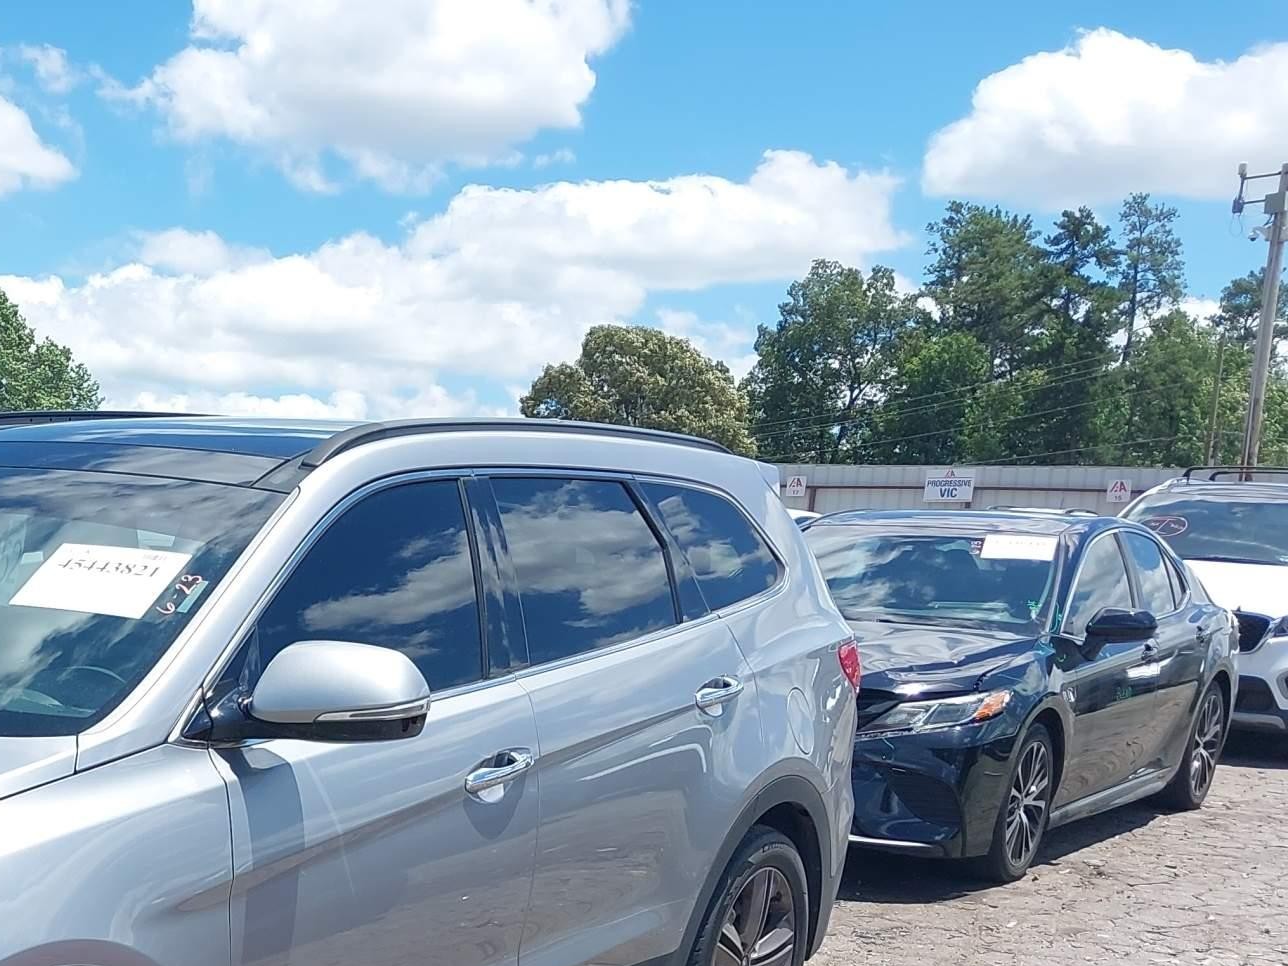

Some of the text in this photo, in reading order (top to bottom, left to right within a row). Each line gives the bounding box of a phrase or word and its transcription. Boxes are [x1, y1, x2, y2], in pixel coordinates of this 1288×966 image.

[926, 479, 973, 488] PROGRESSIVE
[939, 487, 958, 499] VIC
[57, 558, 161, 578] 45443821
